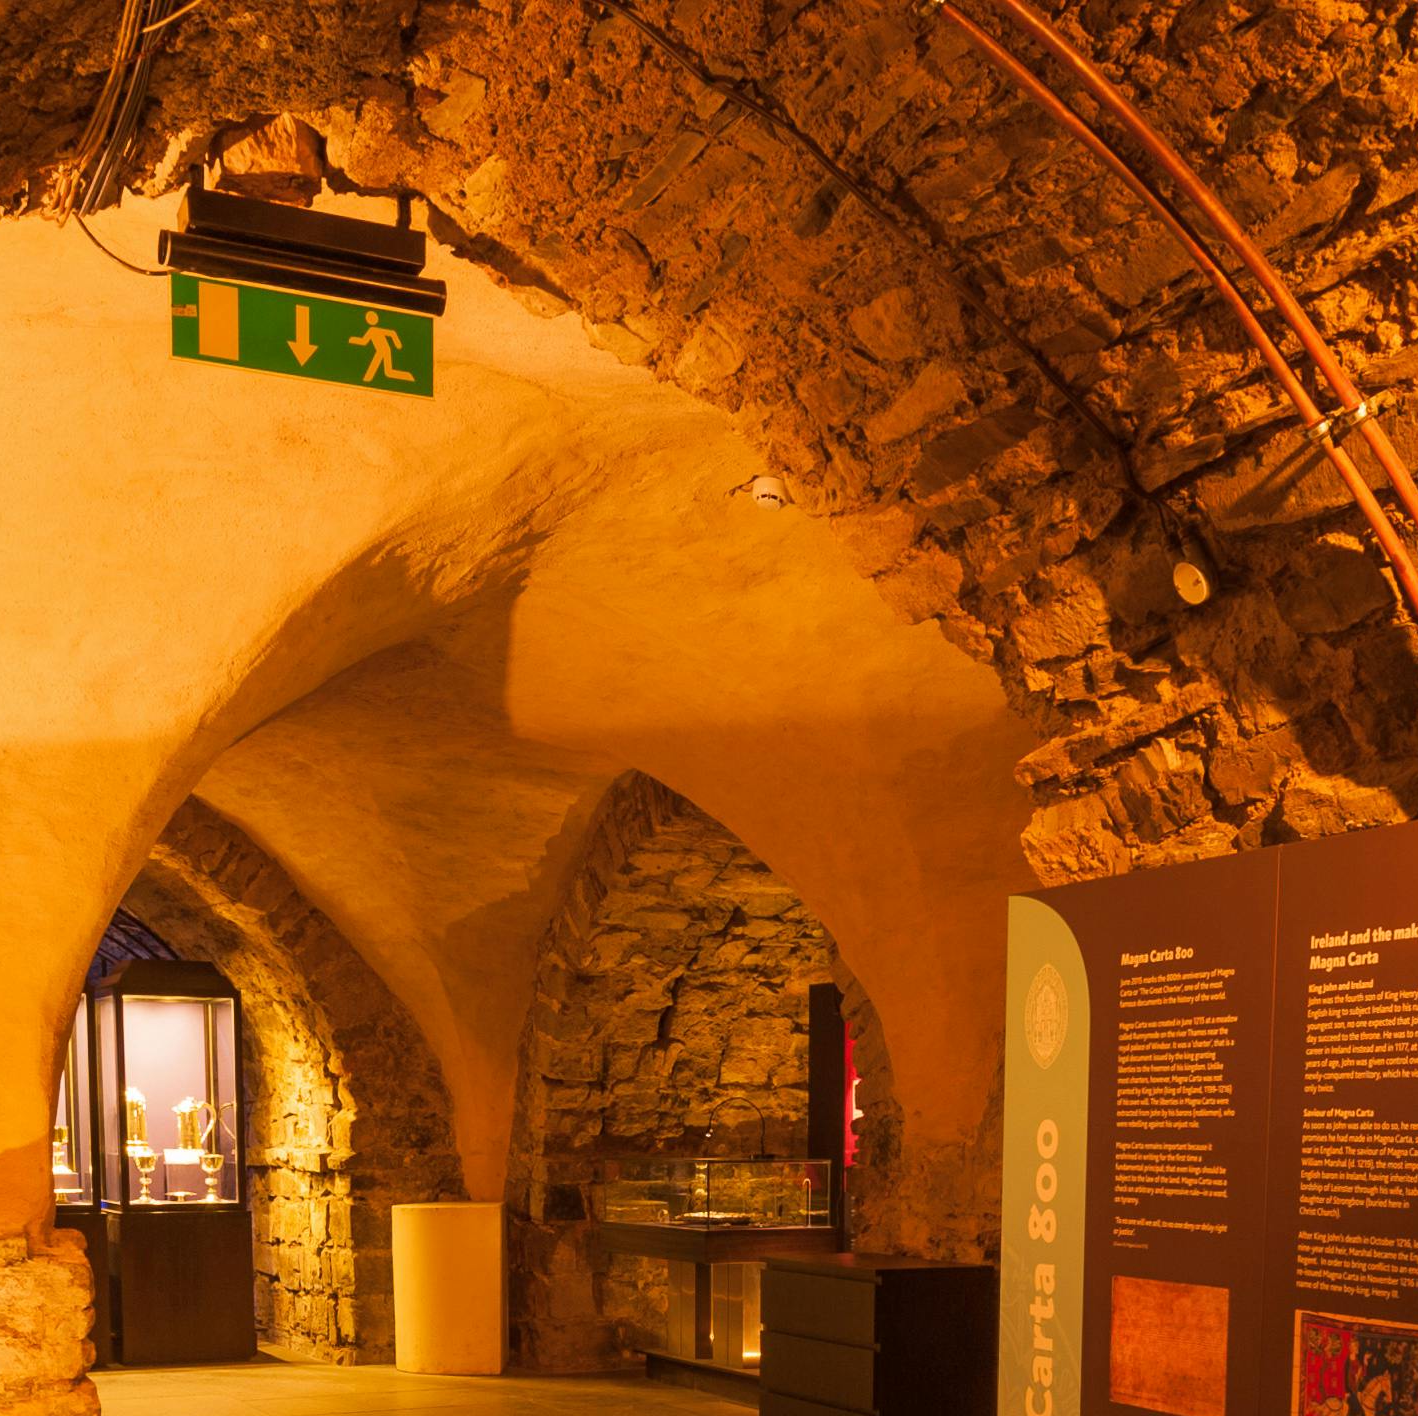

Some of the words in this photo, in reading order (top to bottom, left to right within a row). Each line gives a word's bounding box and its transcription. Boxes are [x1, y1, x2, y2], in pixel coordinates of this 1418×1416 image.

[1310, 931, 1348, 949] Ireland
[1349, 928, 1370, 945] and
[1371, 926, 1392, 942] the
[1120, 953, 1149, 967] Magna
[1149, 949, 1174, 962] Carta
[1174, 946, 1193, 959] 800
[1309, 955, 1346, 972] Magna
[1347, 951, 1379, 966] Carta
[1028, 1119, 1059, 1243] 800
